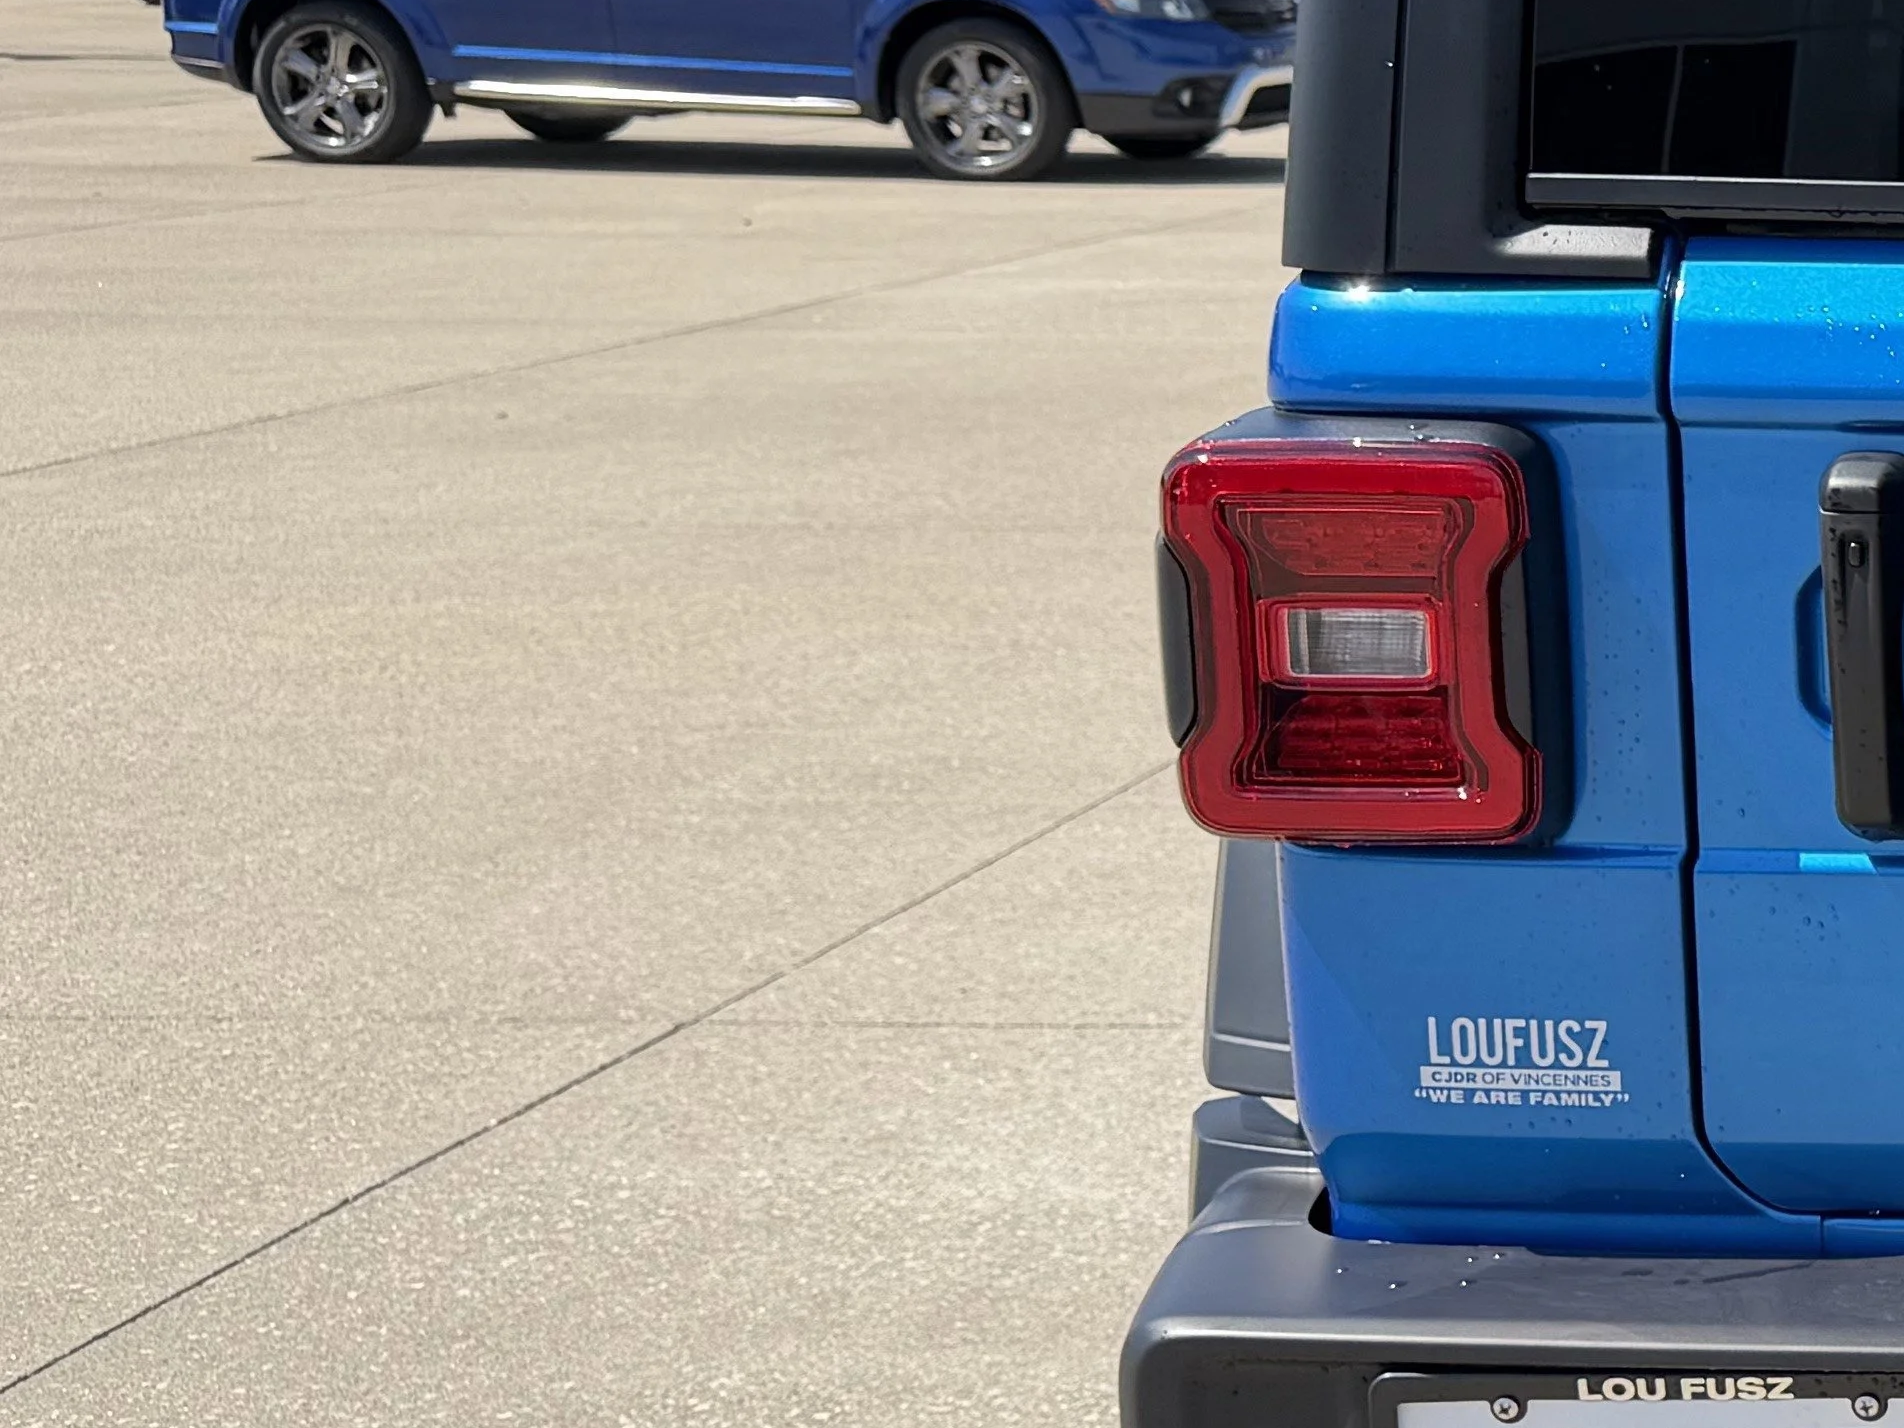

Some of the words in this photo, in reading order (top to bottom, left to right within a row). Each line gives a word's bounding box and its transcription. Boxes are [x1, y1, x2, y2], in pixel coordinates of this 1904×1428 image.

[1431, 1070, 1478, 1084] CJDR
[1481, 1072, 1506, 1085] OF
[1510, 1072, 1612, 1088] VINCENNES
[1472, 1090, 1523, 1106] ARE
[1577, 1377, 1667, 1402] LOU
[1681, 1376, 1796, 1401] FUSZ
